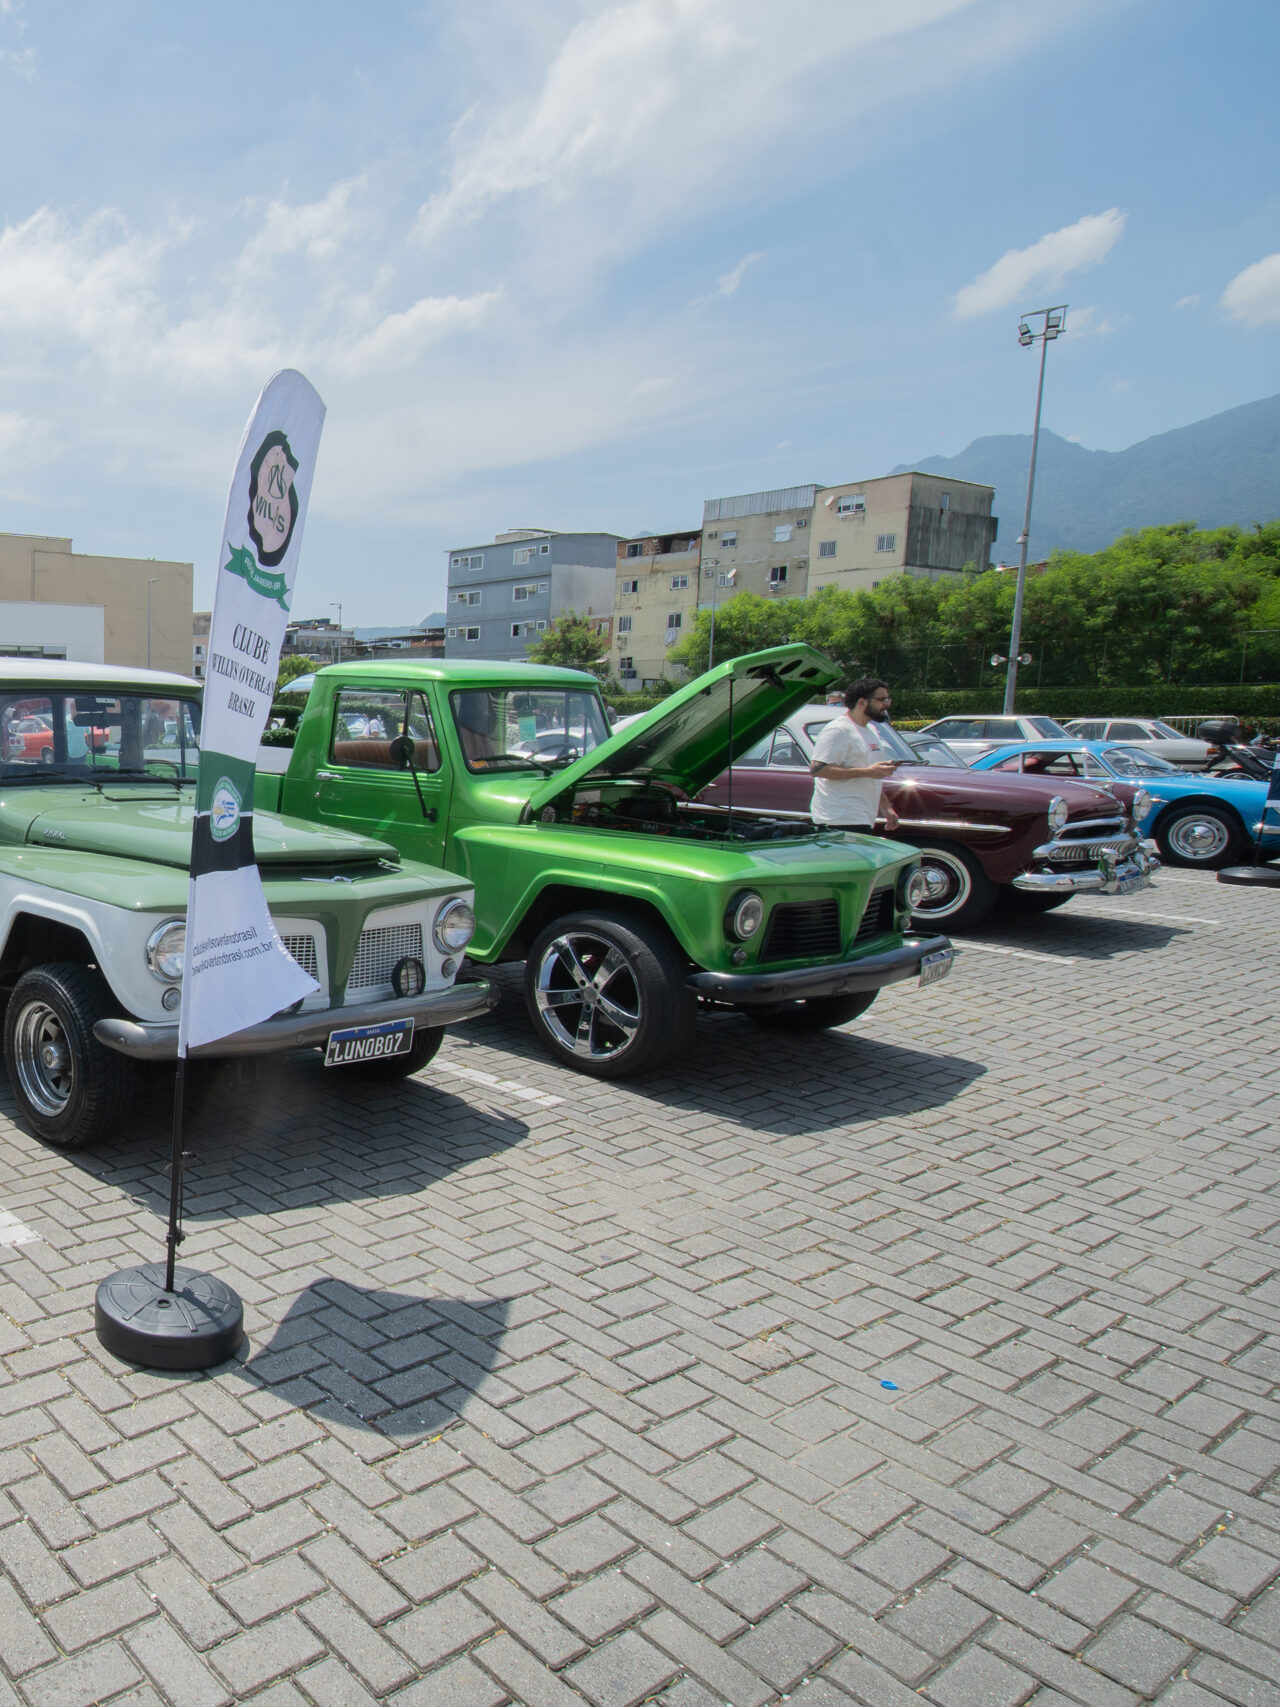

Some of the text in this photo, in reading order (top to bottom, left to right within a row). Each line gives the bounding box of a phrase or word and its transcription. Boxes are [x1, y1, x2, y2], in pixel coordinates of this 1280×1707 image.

[232, 623, 271, 665] CLUBE
[238, 665, 276, 696] OVERLAN
[227, 691, 255, 719] BRASIL
